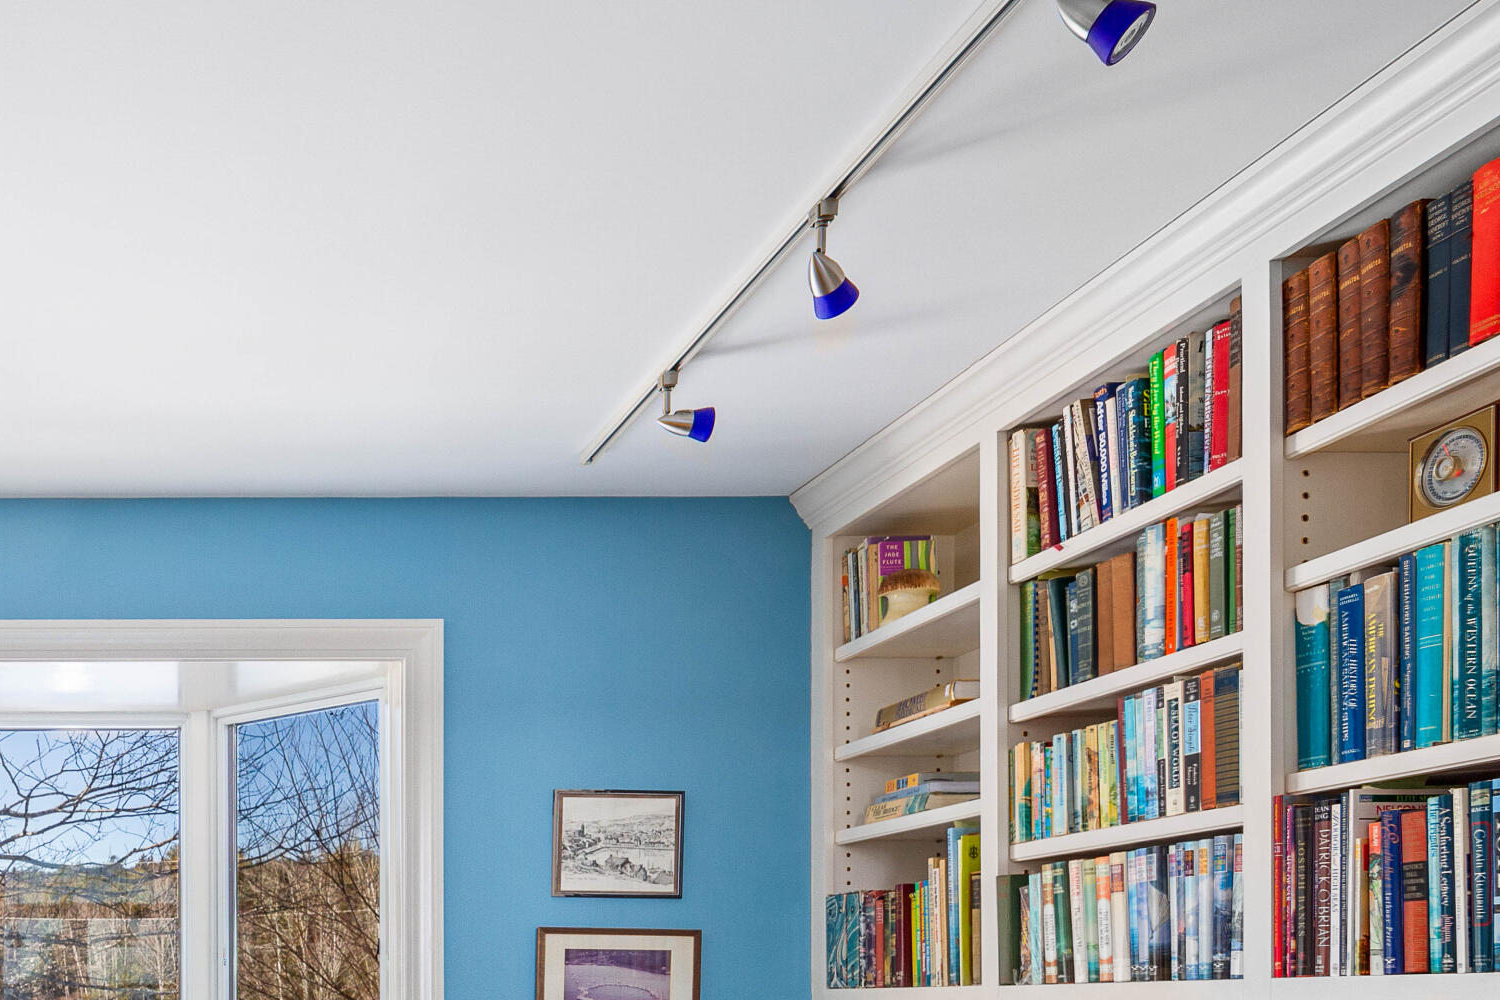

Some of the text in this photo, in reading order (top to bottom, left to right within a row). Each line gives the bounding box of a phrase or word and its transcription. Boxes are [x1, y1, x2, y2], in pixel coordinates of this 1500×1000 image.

[1095, 401, 1109, 506] After 50,000 Miles
[881, 558, 902, 566] FLUTE
[1463, 544, 1478, 592] QUEENS
[1367, 612, 1377, 674] AMERICAN
[1467, 616, 1478, 674] WESTERN
[1467, 678, 1478, 720] OCEAN
[1171, 699, 1181, 788] A SEA OF WORDS
[1297, 840, 1306, 938] JOSEPH BANKS
[1317, 828, 1331, 948] PATRICK O'BRIAN
[1440, 807, 1453, 907] A Seafaring Legacy
